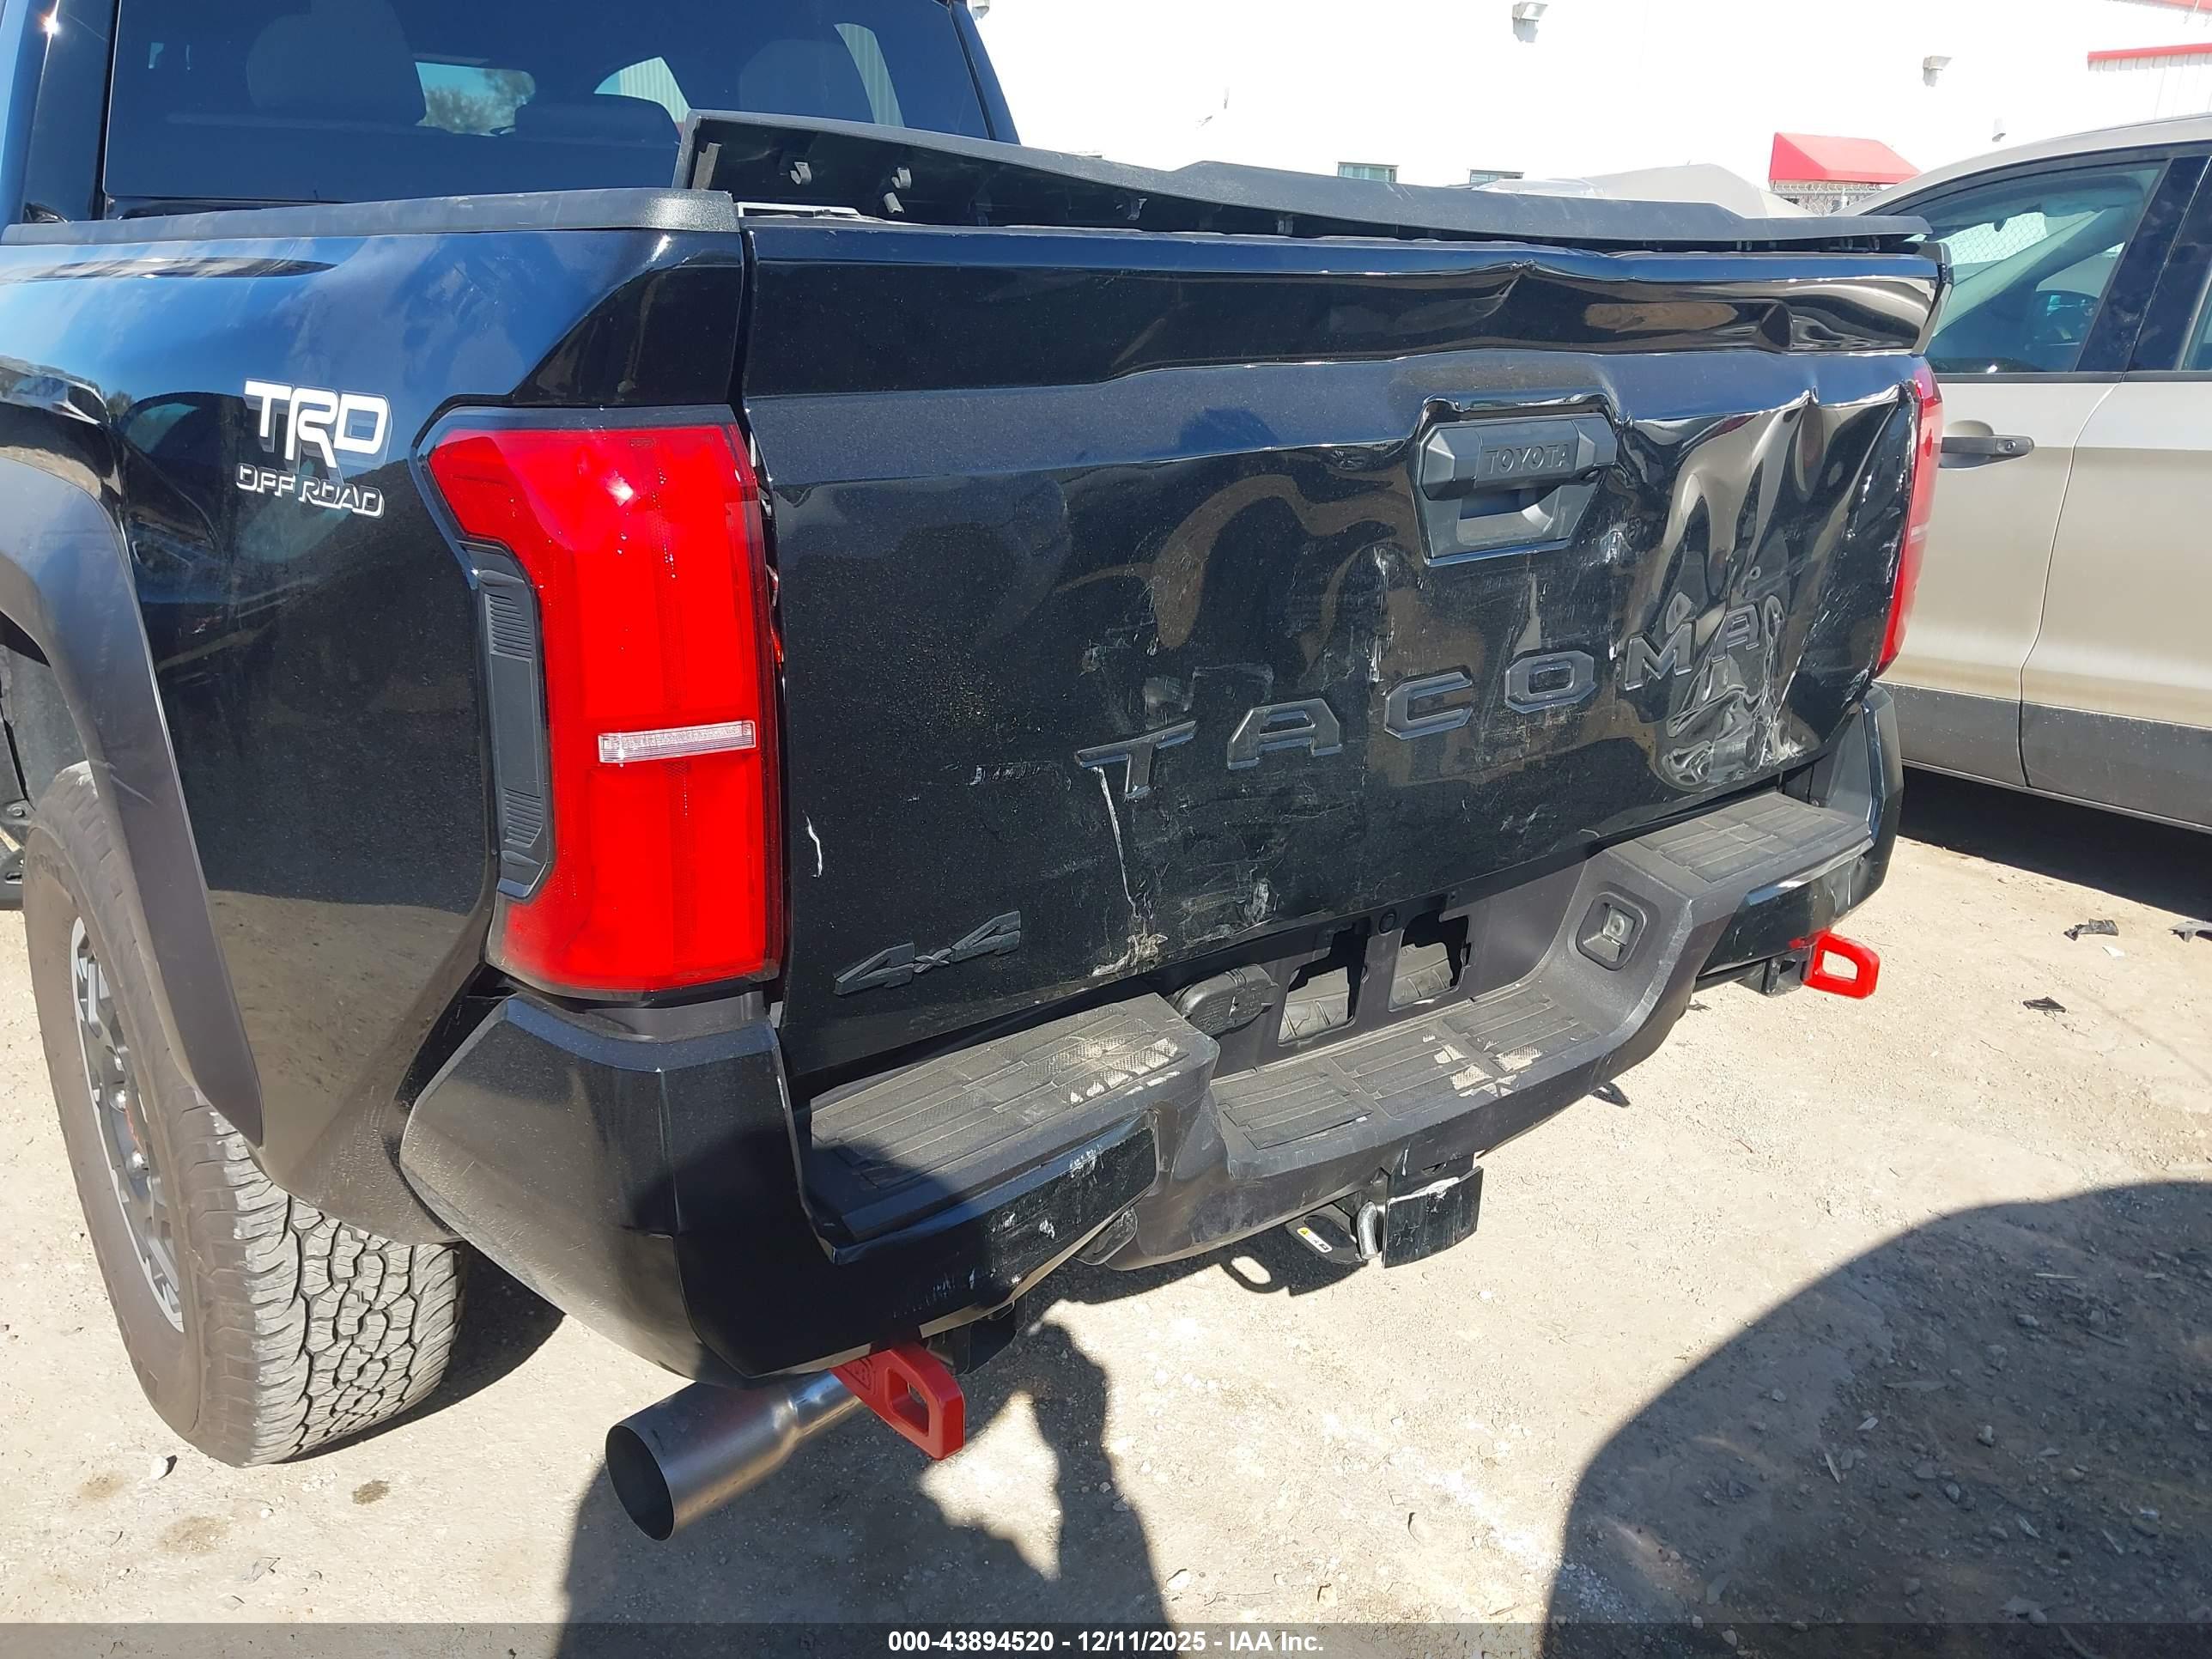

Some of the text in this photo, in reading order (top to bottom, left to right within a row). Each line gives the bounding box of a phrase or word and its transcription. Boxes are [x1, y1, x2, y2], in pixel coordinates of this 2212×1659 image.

[244, 379, 392, 473] TRD
[1483, 442, 1571, 476] TOYOTA
[236, 464, 385, 519] OFF ROAD
[1076, 603, 1763, 799] TACOMA
